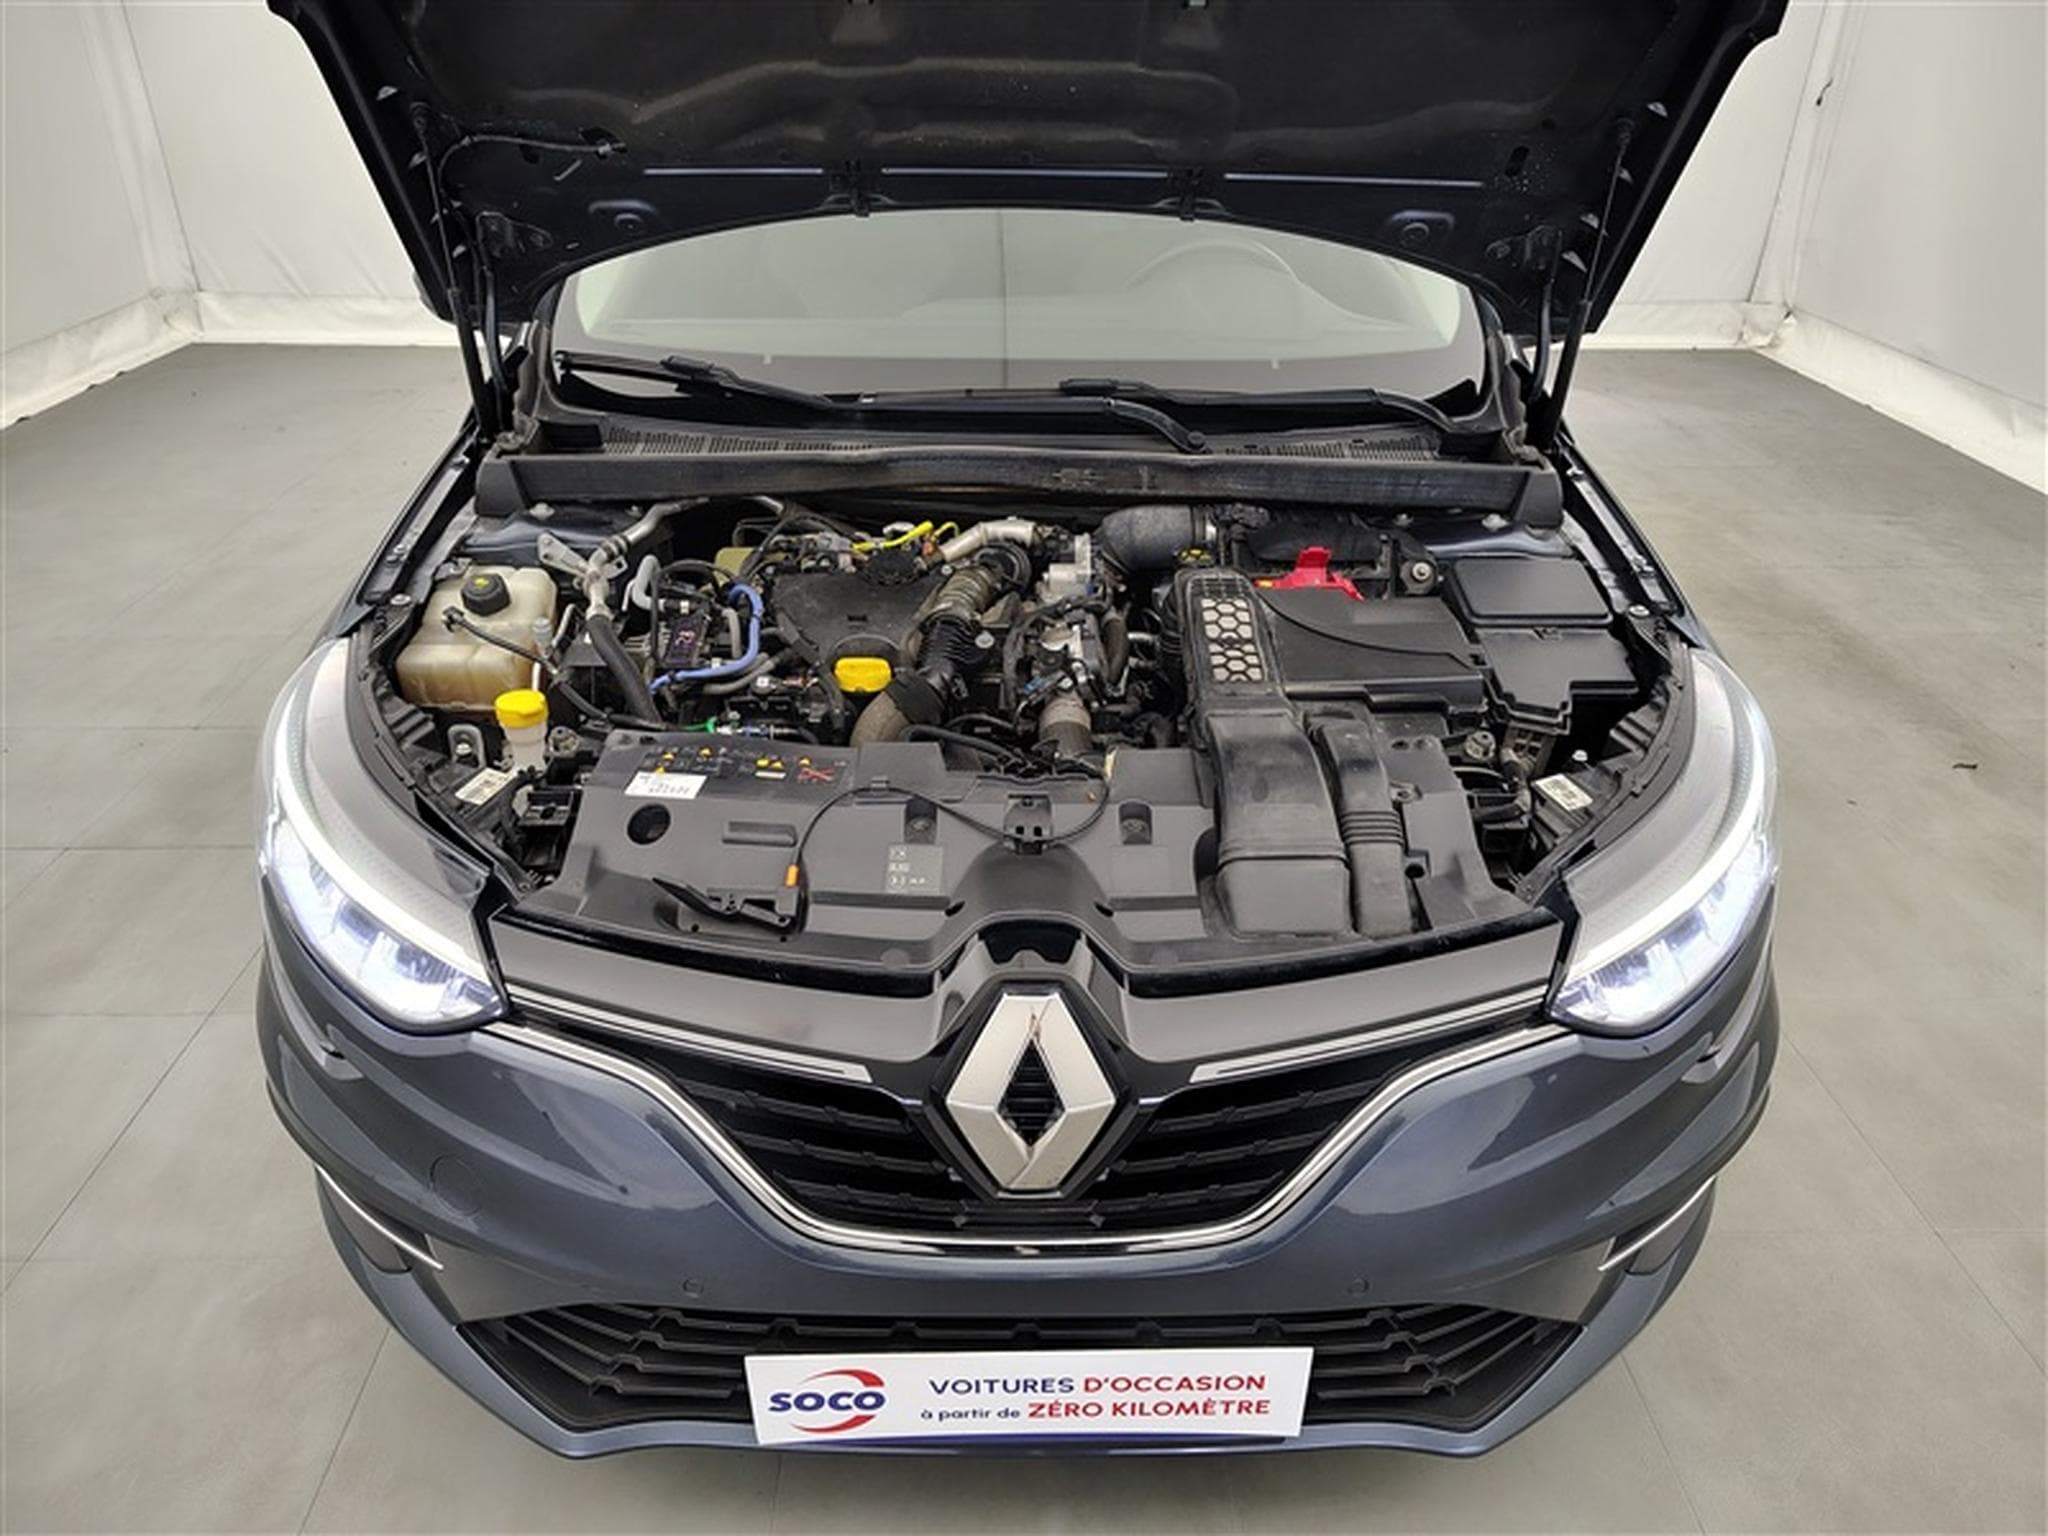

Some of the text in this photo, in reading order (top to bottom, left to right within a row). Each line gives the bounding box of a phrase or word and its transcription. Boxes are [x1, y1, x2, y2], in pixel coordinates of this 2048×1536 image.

[929, 1375, 1266, 1395] VOITURES D'OCCASION
[768, 1391, 886, 1412] SOCO
[921, 1398, 1271, 1422] à partir de ZÉRO KILOMÈTRE
